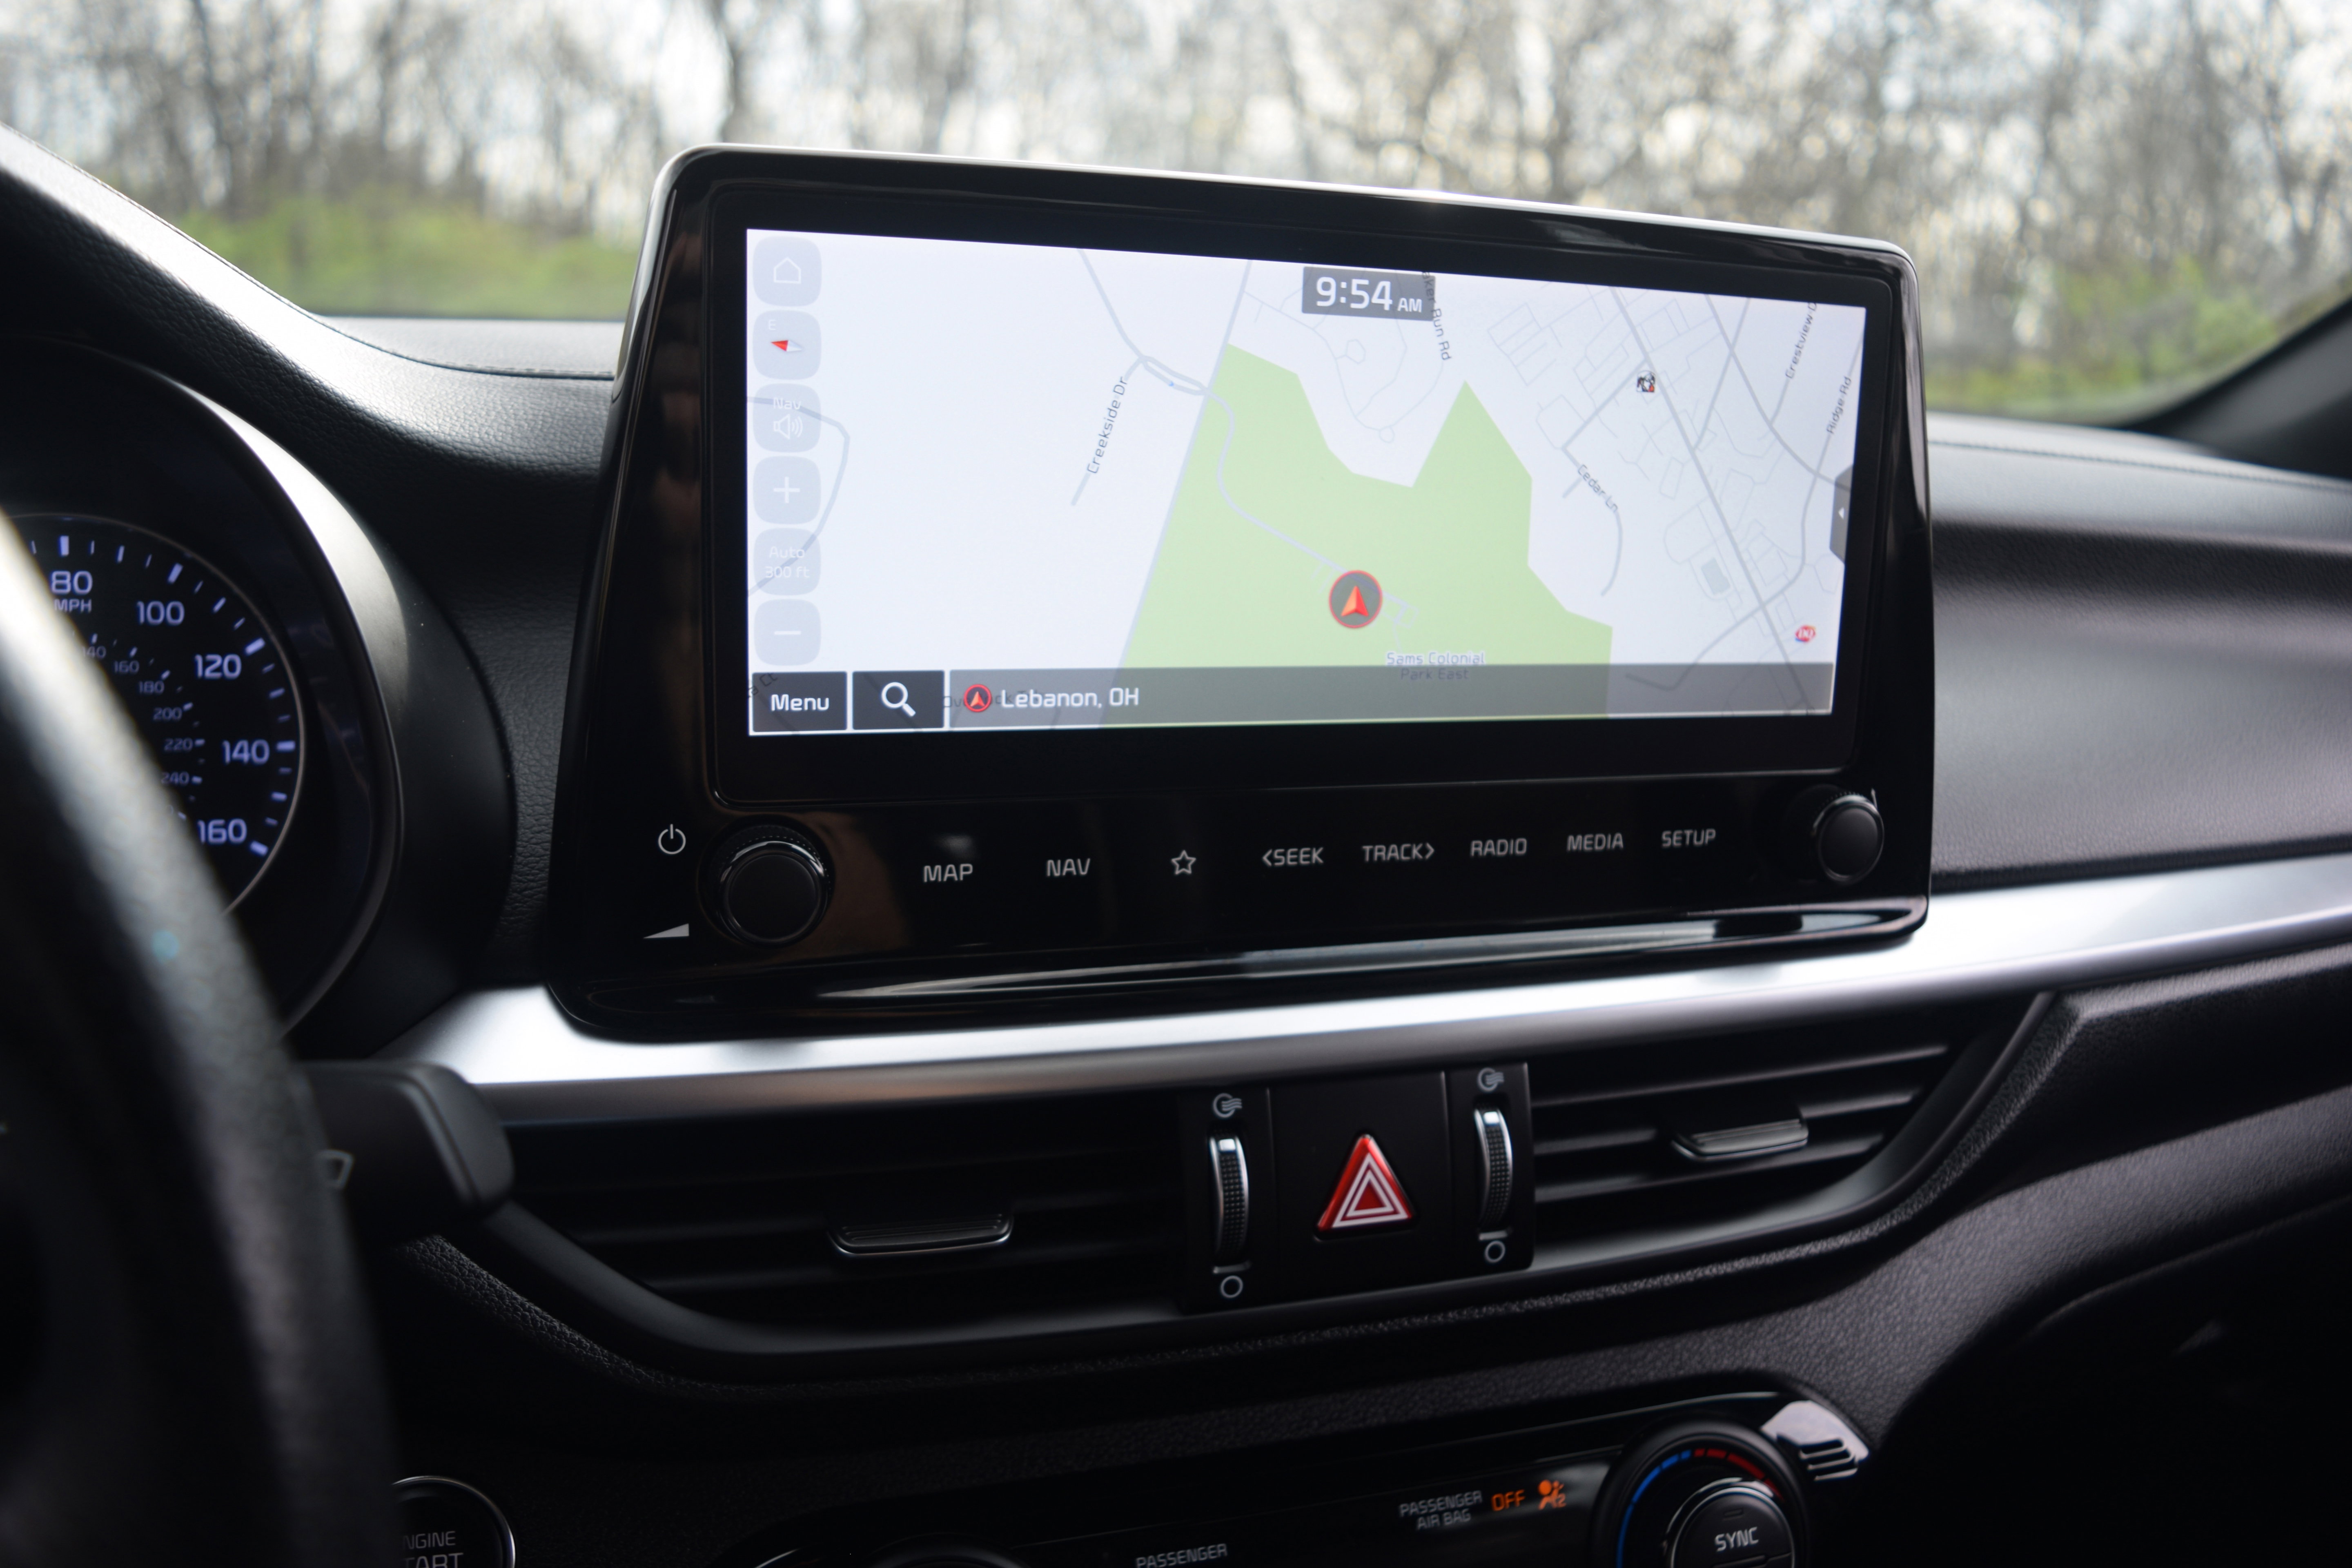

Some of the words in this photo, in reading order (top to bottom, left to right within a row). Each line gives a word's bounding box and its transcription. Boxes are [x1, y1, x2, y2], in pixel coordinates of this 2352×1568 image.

[1316, 277, 1392, 310] 9:54
[1397, 298, 1423, 313] AM
[768, 319, 776, 331] E
[1431, 309, 1443, 337] Run
[1439, 341, 1451, 360] Rd
[1785, 314, 1813, 379] Crestview
[773, 397, 802, 410] Nav
[1826, 399, 1845, 434] Ridge
[1840, 376, 1851, 395] Rd
[1087, 400, 1121, 474] Creekside
[1113, 376, 1127, 395] Dr
[1578, 464, 1606, 495] Cedar
[1606, 495, 1618, 512] Ln
[769, 546, 804, 558] Auto
[766, 566, 791, 578] 300
[797, 566, 809, 578] ft
[51, 571, 93, 595] 80
[54, 598, 92, 613] MPH
[137, 601, 185, 625] 100
[114, 660, 139, 673] 160
[195, 654, 241, 679] 120
[1387, 652, 1424, 664] Sams
[1429, 652, 1484, 664] Colonial
[1401, 668, 1433, 679] Park
[1439, 668, 1469, 679] East
[139, 680, 165, 694] 180
[771, 694, 829, 711] Menu
[1001, 689, 1102, 708] Lebanon,
[1109, 688, 1139, 706] OH
[154, 707, 182, 720] 200
[164, 738, 193, 751] 220
[223, 739, 270, 764] 140
[162, 771, 189, 784] 240
[198, 819, 247, 844] 160
[1662, 829, 1716, 847] SETUP
[1471, 838, 1527, 856] RADIO
[1567, 833, 1624, 851] MEDIA
[924, 864, 973, 882] MAP
[1046, 858, 1090, 877] NAV
[1399, 1490, 1482, 1517] PASSENGER
[1492, 1489, 1526, 1511] OFF
[1417, 1514, 1440, 1530] AIR
[1443, 1508, 1471, 1526] BAG
[403, 1531, 456, 1550] NGINE
[1715, 1527, 1759, 1552] SYNC
[401, 1553, 464, 1568] TART
[1135, 1544, 1227, 1568] PASSENGER
